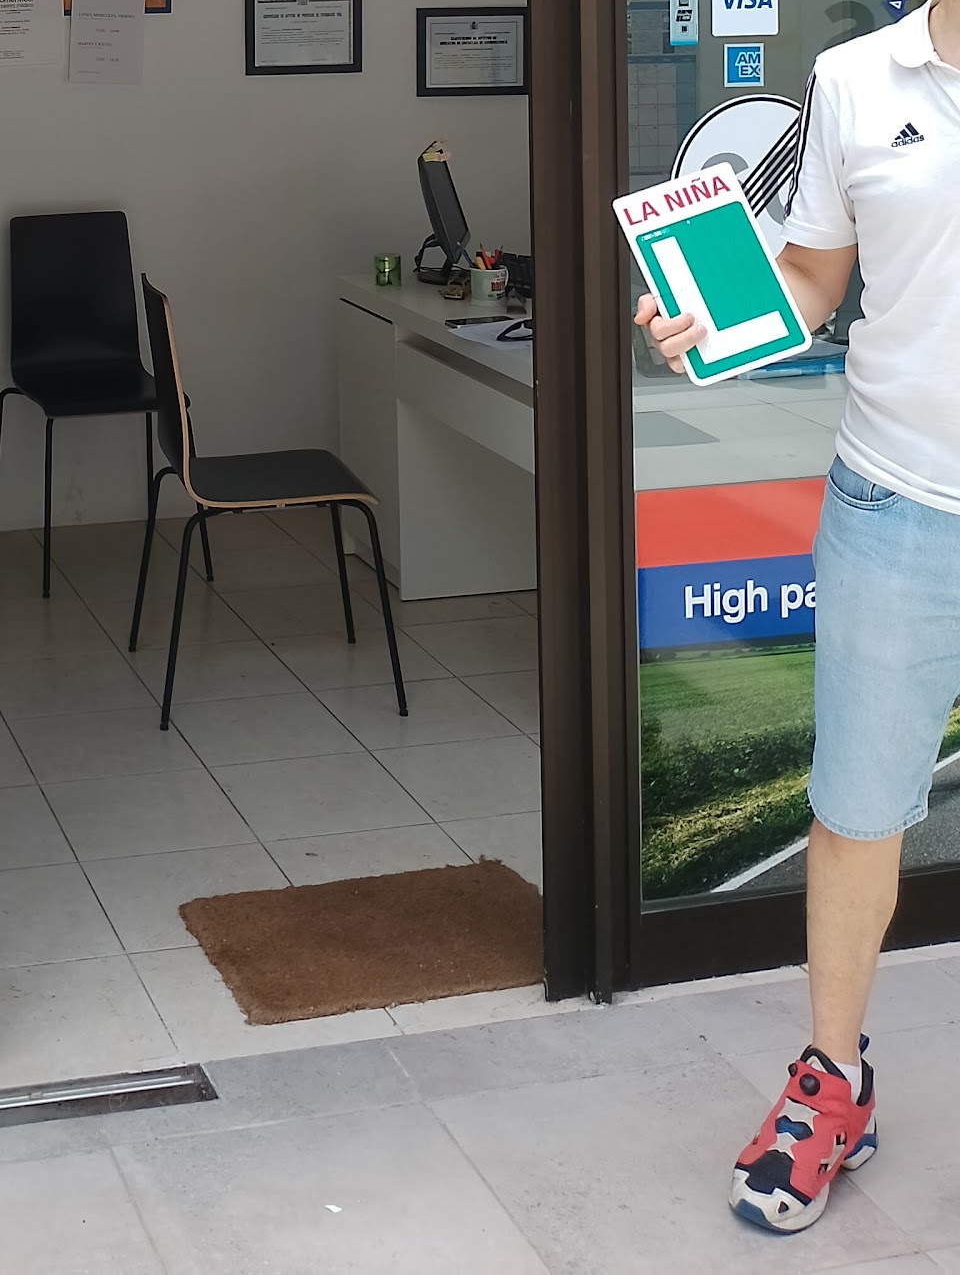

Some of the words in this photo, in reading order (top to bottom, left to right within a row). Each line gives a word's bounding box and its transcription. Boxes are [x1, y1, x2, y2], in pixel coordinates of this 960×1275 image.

[891, 135, 924, 147] adidas
[623, 201, 660, 226] LA
[664, 175, 731, 212] NIÑA
[651, 236, 789, 365] L
[685, 579, 768, 624] High
